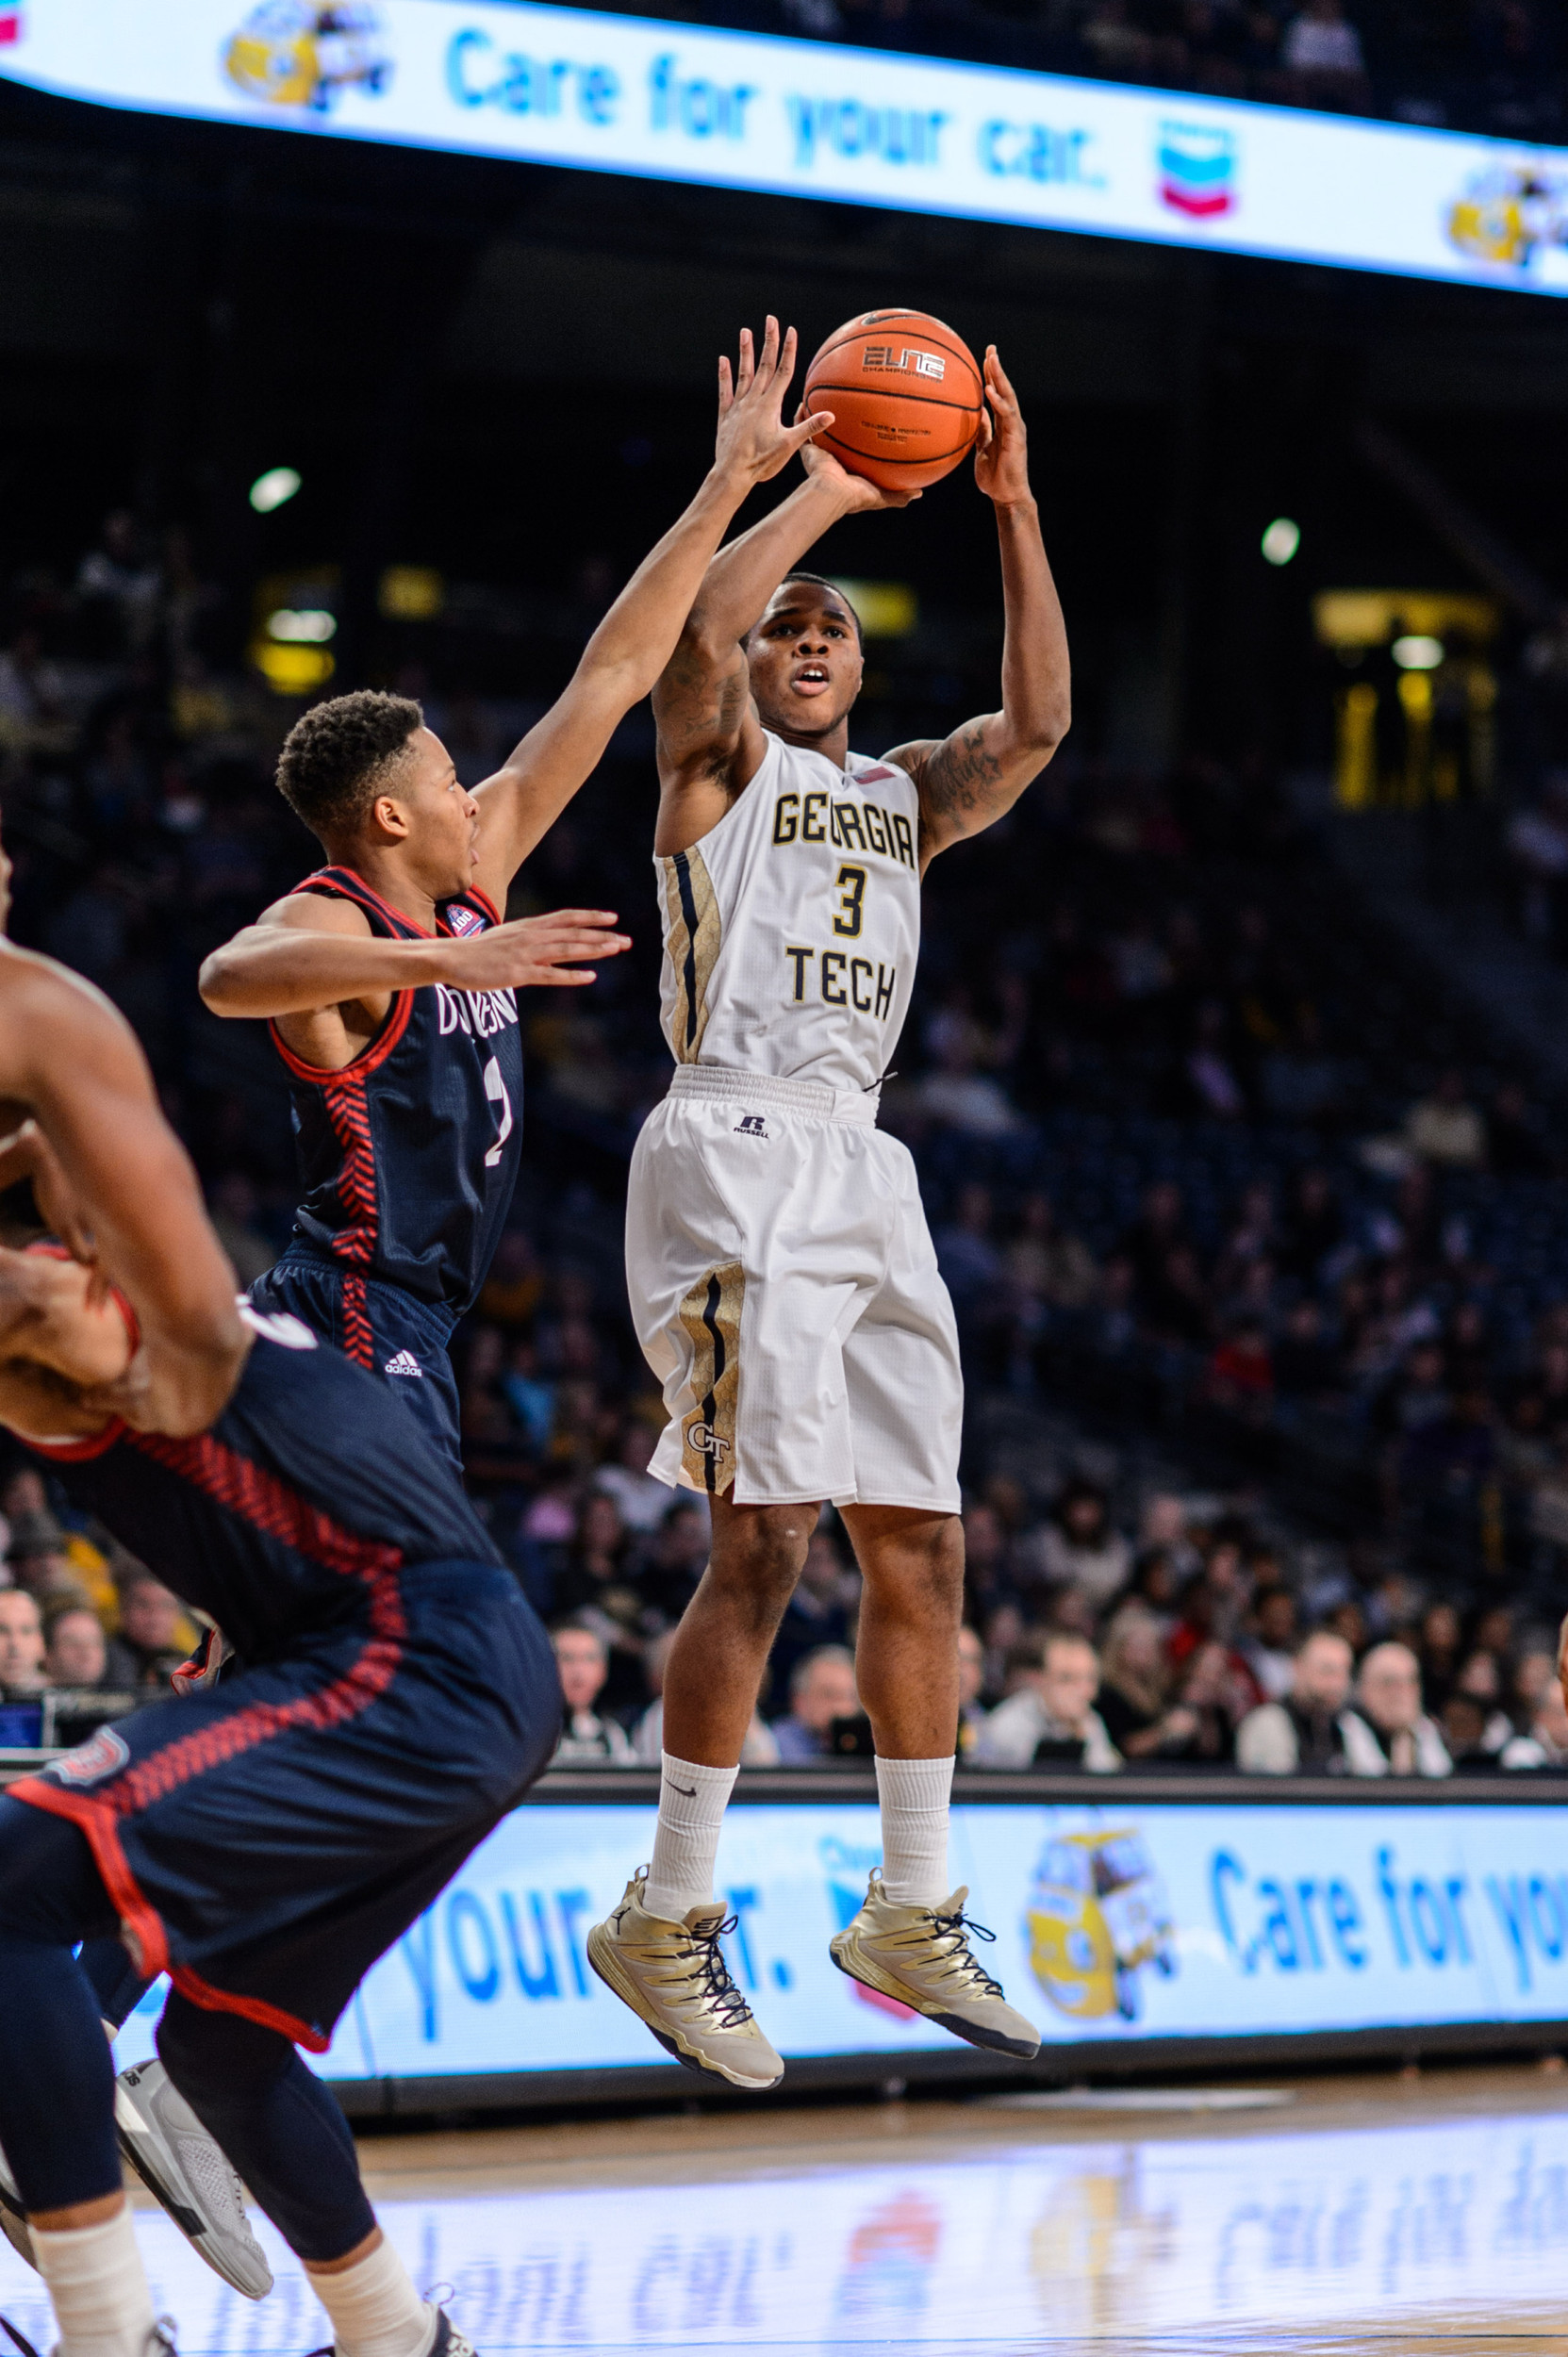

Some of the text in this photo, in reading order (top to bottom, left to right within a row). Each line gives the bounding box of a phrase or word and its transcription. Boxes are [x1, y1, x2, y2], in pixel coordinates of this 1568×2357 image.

[445, 26, 1106, 187] Care for your car.
[771, 792, 916, 871] GEORGIA
[452, 910, 473, 932] 100
[833, 864, 867, 940] 3
[785, 946, 896, 1023] TECH
[733, 1127, 769, 1140] RUSSELL
[385, 1363, 422, 1377] adidas
[686, 1420, 731, 1464] GT
[1210, 1844, 1368, 1975] Care
[1374, 1840, 1473, 1970] for
[396, 1885, 594, 2044] your
